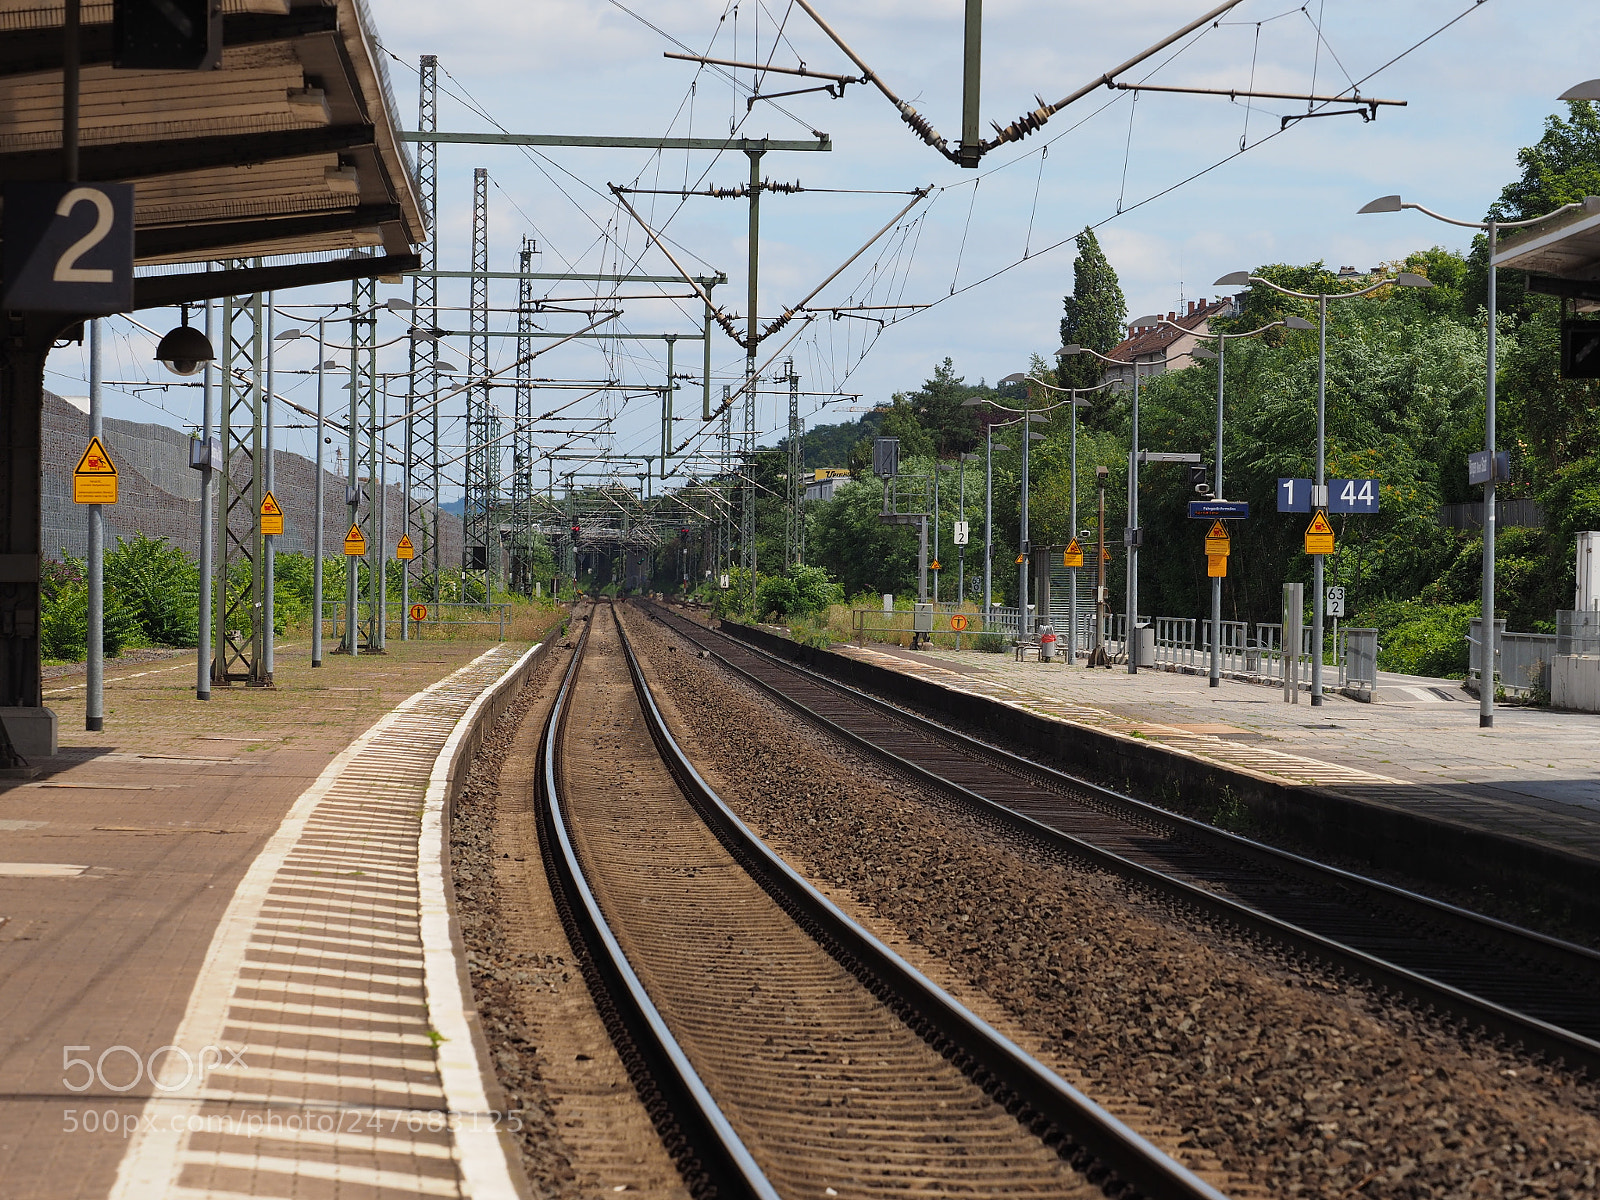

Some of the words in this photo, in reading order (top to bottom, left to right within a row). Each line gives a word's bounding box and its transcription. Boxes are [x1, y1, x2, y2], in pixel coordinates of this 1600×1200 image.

[52, 187, 114, 283] 2
[1282, 479, 1294, 505] 1
[1340, 480, 1374, 506] 44
[959, 523, 964, 532] 1
[958, 533, 965, 542] 2
[1328, 588, 1344, 600] 63
[1332, 601, 1340, 613] 2
